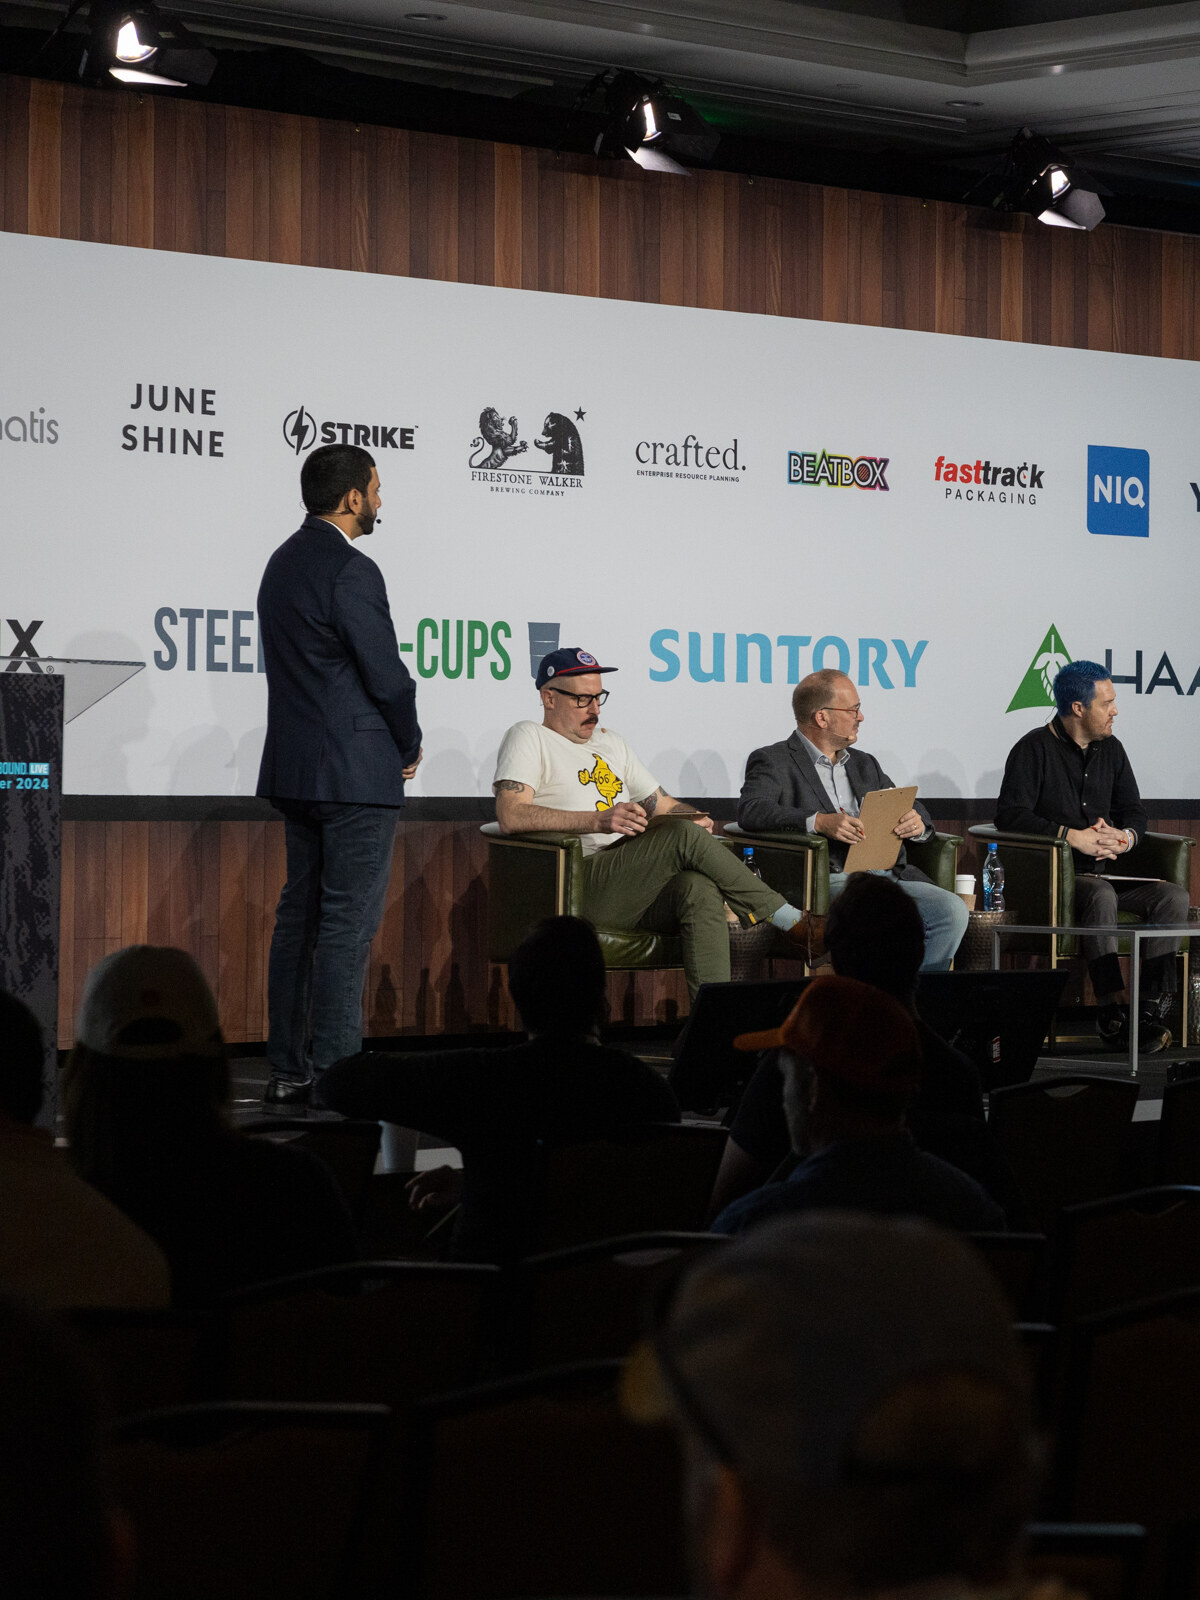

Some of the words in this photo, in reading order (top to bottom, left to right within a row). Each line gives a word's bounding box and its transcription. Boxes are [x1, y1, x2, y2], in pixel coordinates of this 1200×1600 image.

[130, 383, 216, 416] JUNE
[121, 424, 224, 458] SHINE
[636, 470, 673, 478] ENTERPRISE
[675, 472, 707, 480] RESOURCE
[709, 474, 740, 482] PLANNING
[789, 450, 888, 490] BEATBOX
[934, 455, 1045, 489] fasttrack
[471, 471, 532, 485] FIRESTONE
[539, 475, 583, 488] WALKER
[490, 486, 526, 494] BREWING
[945, 488, 1036, 506] PACKAGING
[1094, 474, 1146, 509] NIQ
[30, 764, 48, 774] LIVE
[16, 777, 49, 790] 2024
